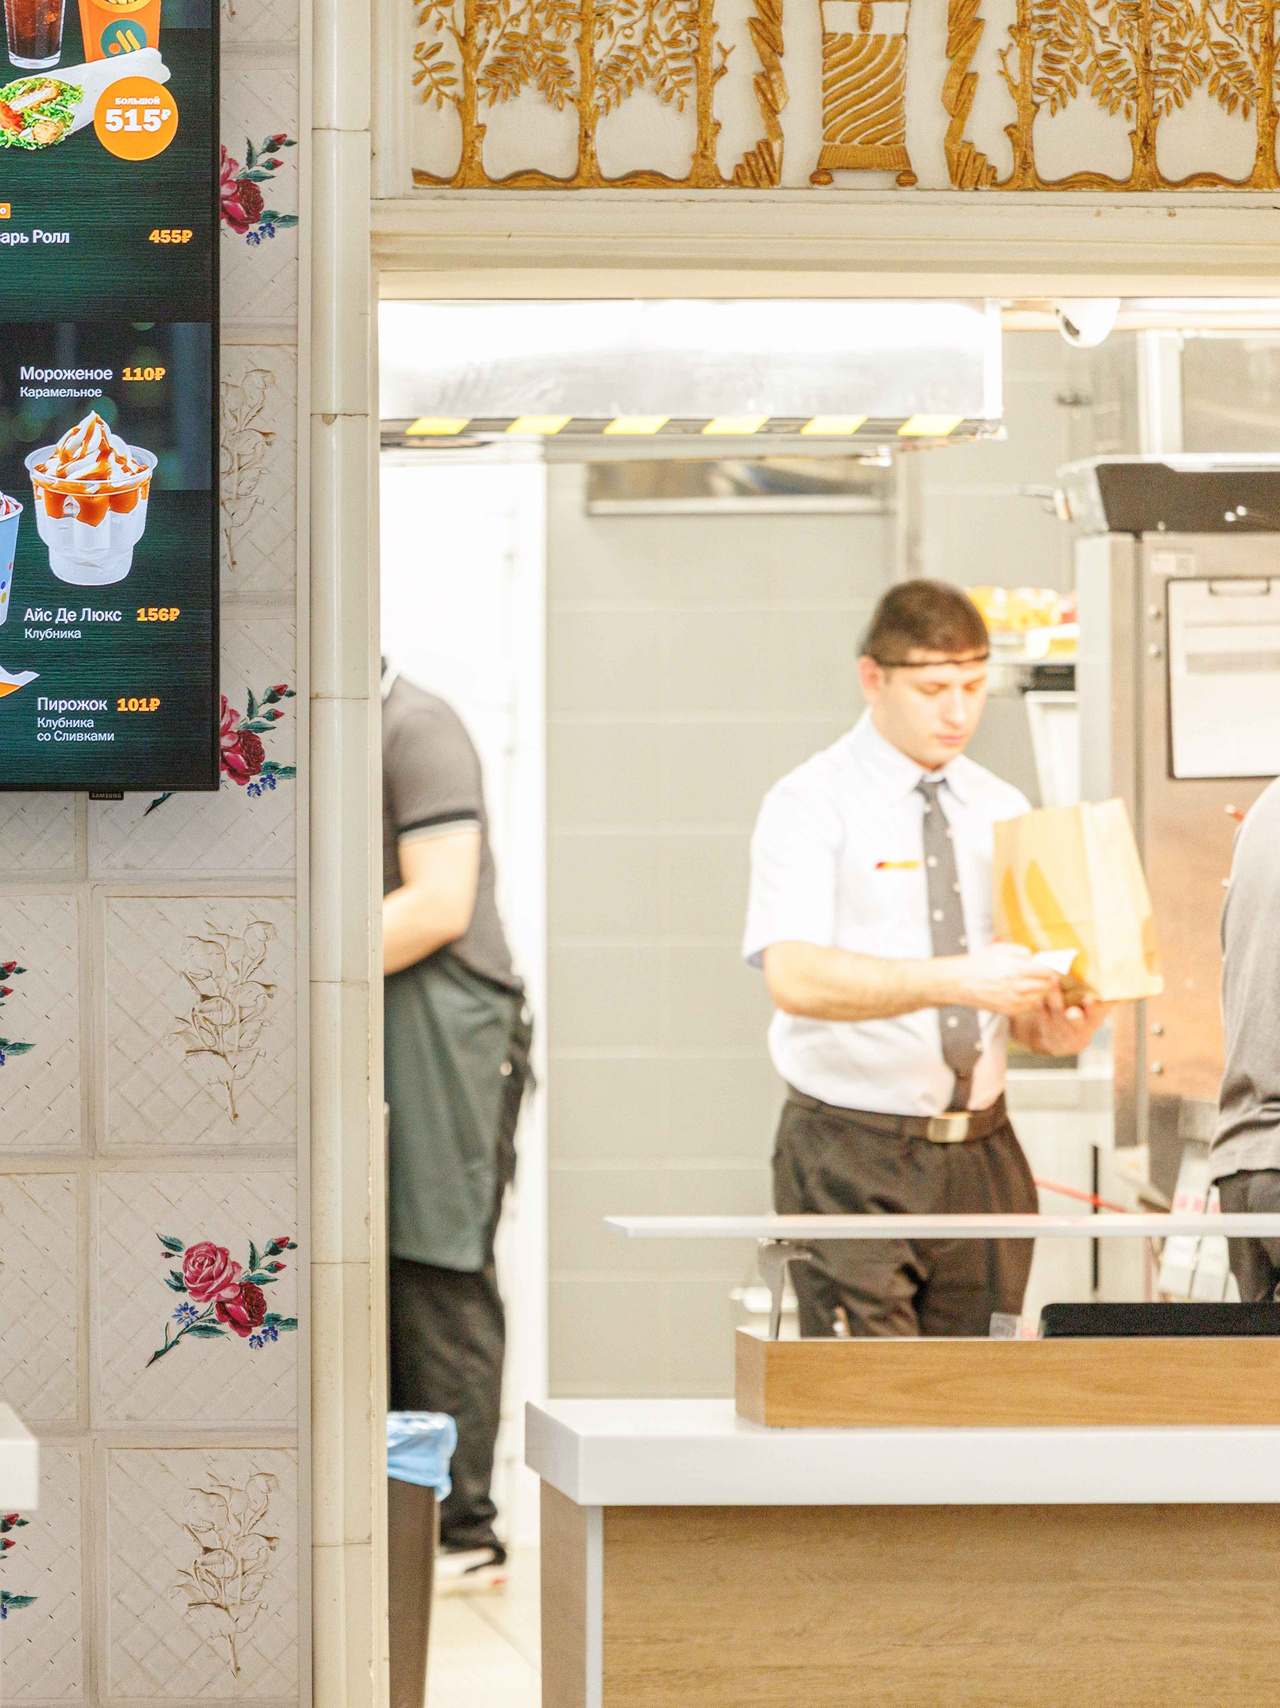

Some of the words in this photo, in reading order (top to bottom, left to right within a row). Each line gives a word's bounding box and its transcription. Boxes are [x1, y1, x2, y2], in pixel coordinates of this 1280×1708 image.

[115, 96, 160, 105] БОЛЬШОЙ
[105, 109, 171, 131] 515₽
[33, 230, 69, 243] Ролл
[149, 230, 192, 243] 455₽
[21, 367, 113, 382] Мороженое
[122, 368, 165, 381] 110₽
[21, 387, 102, 399] Карамельное
[24, 608, 52, 621] Айс
[55, 608, 76, 623] Де
[80, 608, 121, 621] Люкс
[137, 608, 180, 621] 156₽
[25, 628, 81, 640] Клубника
[38, 697, 107, 713] Пирожок
[118, 698, 160, 711] 101₽
[38, 717, 94, 730] Клубника
[37, 733, 51, 741] со
[54, 730, 114, 741] Сливками
